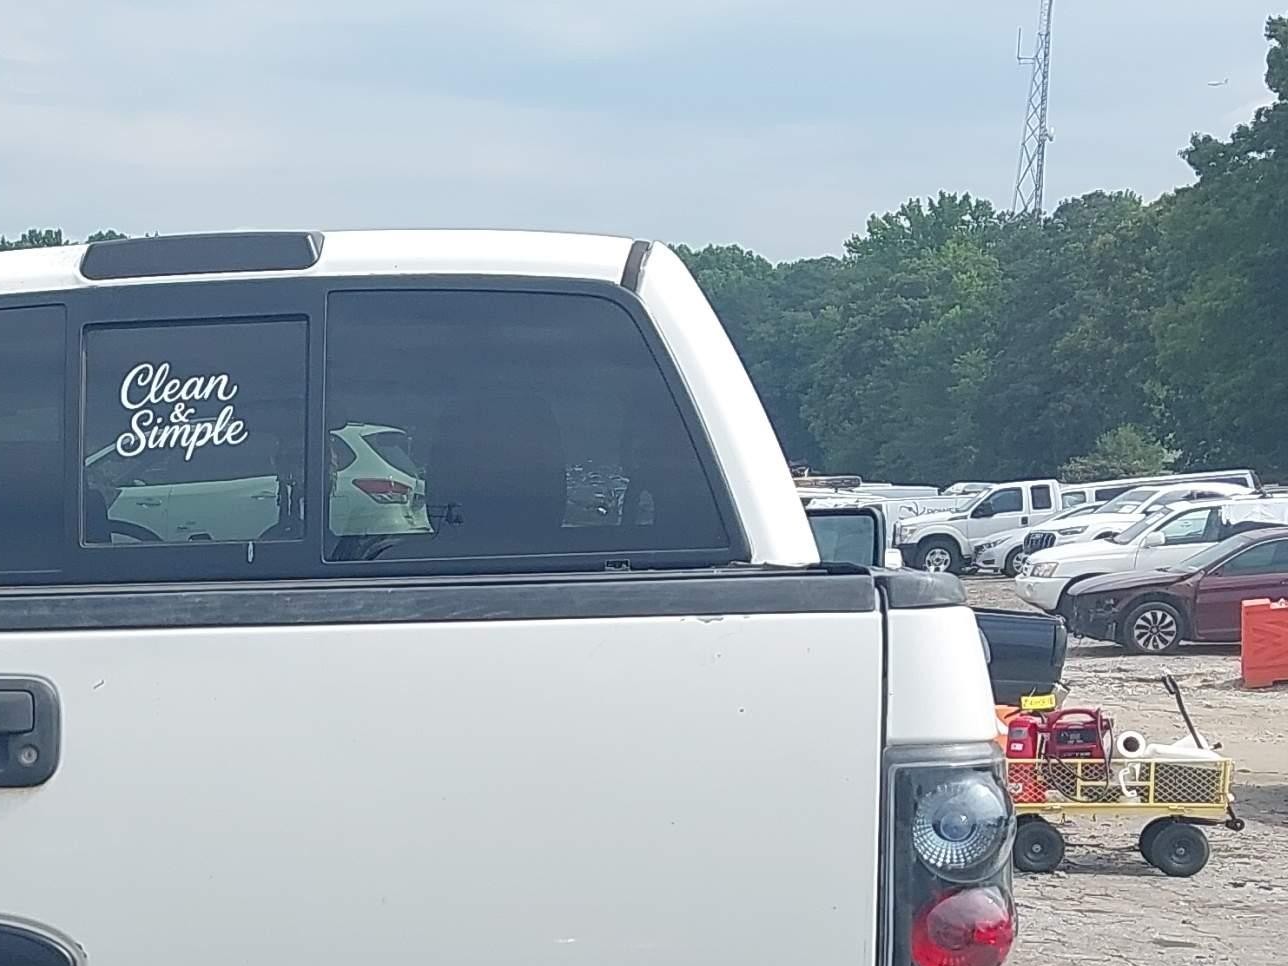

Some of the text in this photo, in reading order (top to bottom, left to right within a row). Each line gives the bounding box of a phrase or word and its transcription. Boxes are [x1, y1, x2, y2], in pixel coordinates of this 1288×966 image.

[120, 363, 237, 409] Clean
[117, 405, 248, 461] Simple
[169, 402, 195, 422] &
